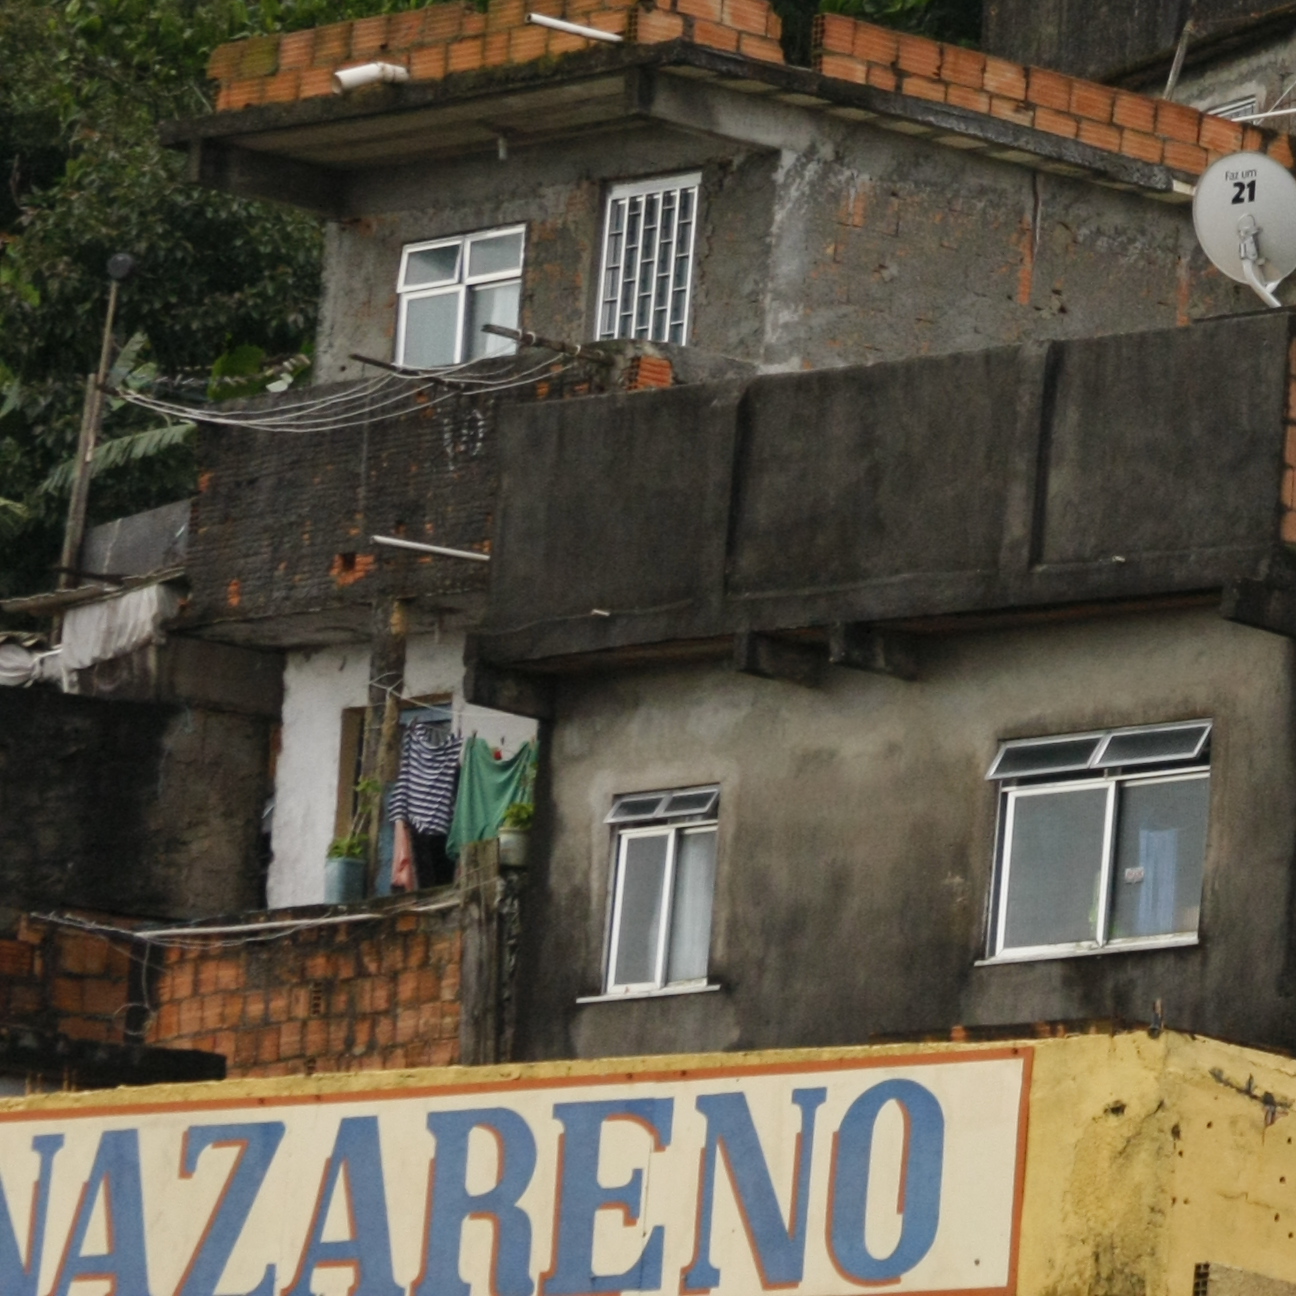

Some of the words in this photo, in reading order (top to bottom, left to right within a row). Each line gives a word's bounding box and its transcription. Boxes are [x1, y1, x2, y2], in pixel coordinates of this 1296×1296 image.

[1225, 170, 1239, 181] Faz
[1241, 169, 1257, 179] um
[1231, 179, 1256, 205] 21
